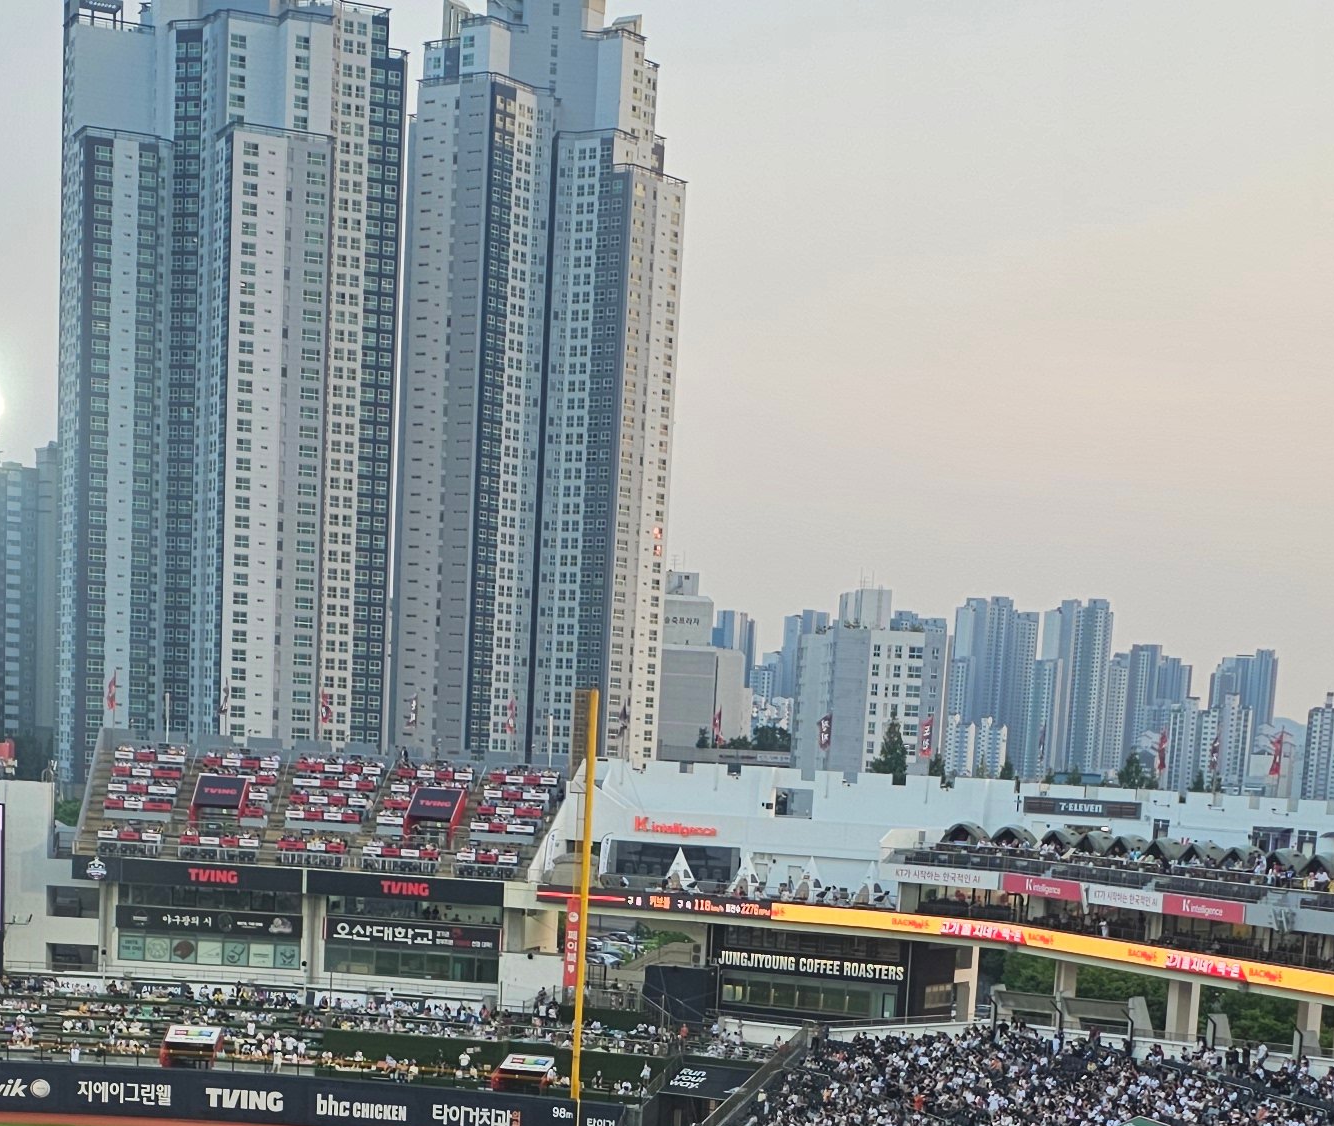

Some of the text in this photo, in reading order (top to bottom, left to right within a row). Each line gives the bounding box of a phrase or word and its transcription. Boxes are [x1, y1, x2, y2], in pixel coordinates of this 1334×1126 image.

[1059, 801, 1103, 814] 7-ELEVEN
[188, 867, 238, 885] TVING
[895, 870, 981, 884] KT가 시작하는 한국적인 AI
[380, 879, 430, 897] TVING
[333, 922, 433, 945] 오산대학교
[718, 950, 905, 982] JUNGJIYOUNG COFFEE ROASTERS
[674, 1074, 707, 1085] your
[679, 1067, 707, 1078] Run
[77, 1080, 171, 1106] 지에이그린웰
[669, 1079, 700, 1090] way.
[205, 1087, 284, 1112] TVING
[316, 1093, 407, 1122] bhc CHICKEN
[551, 1106, 574, 1120] 98m
